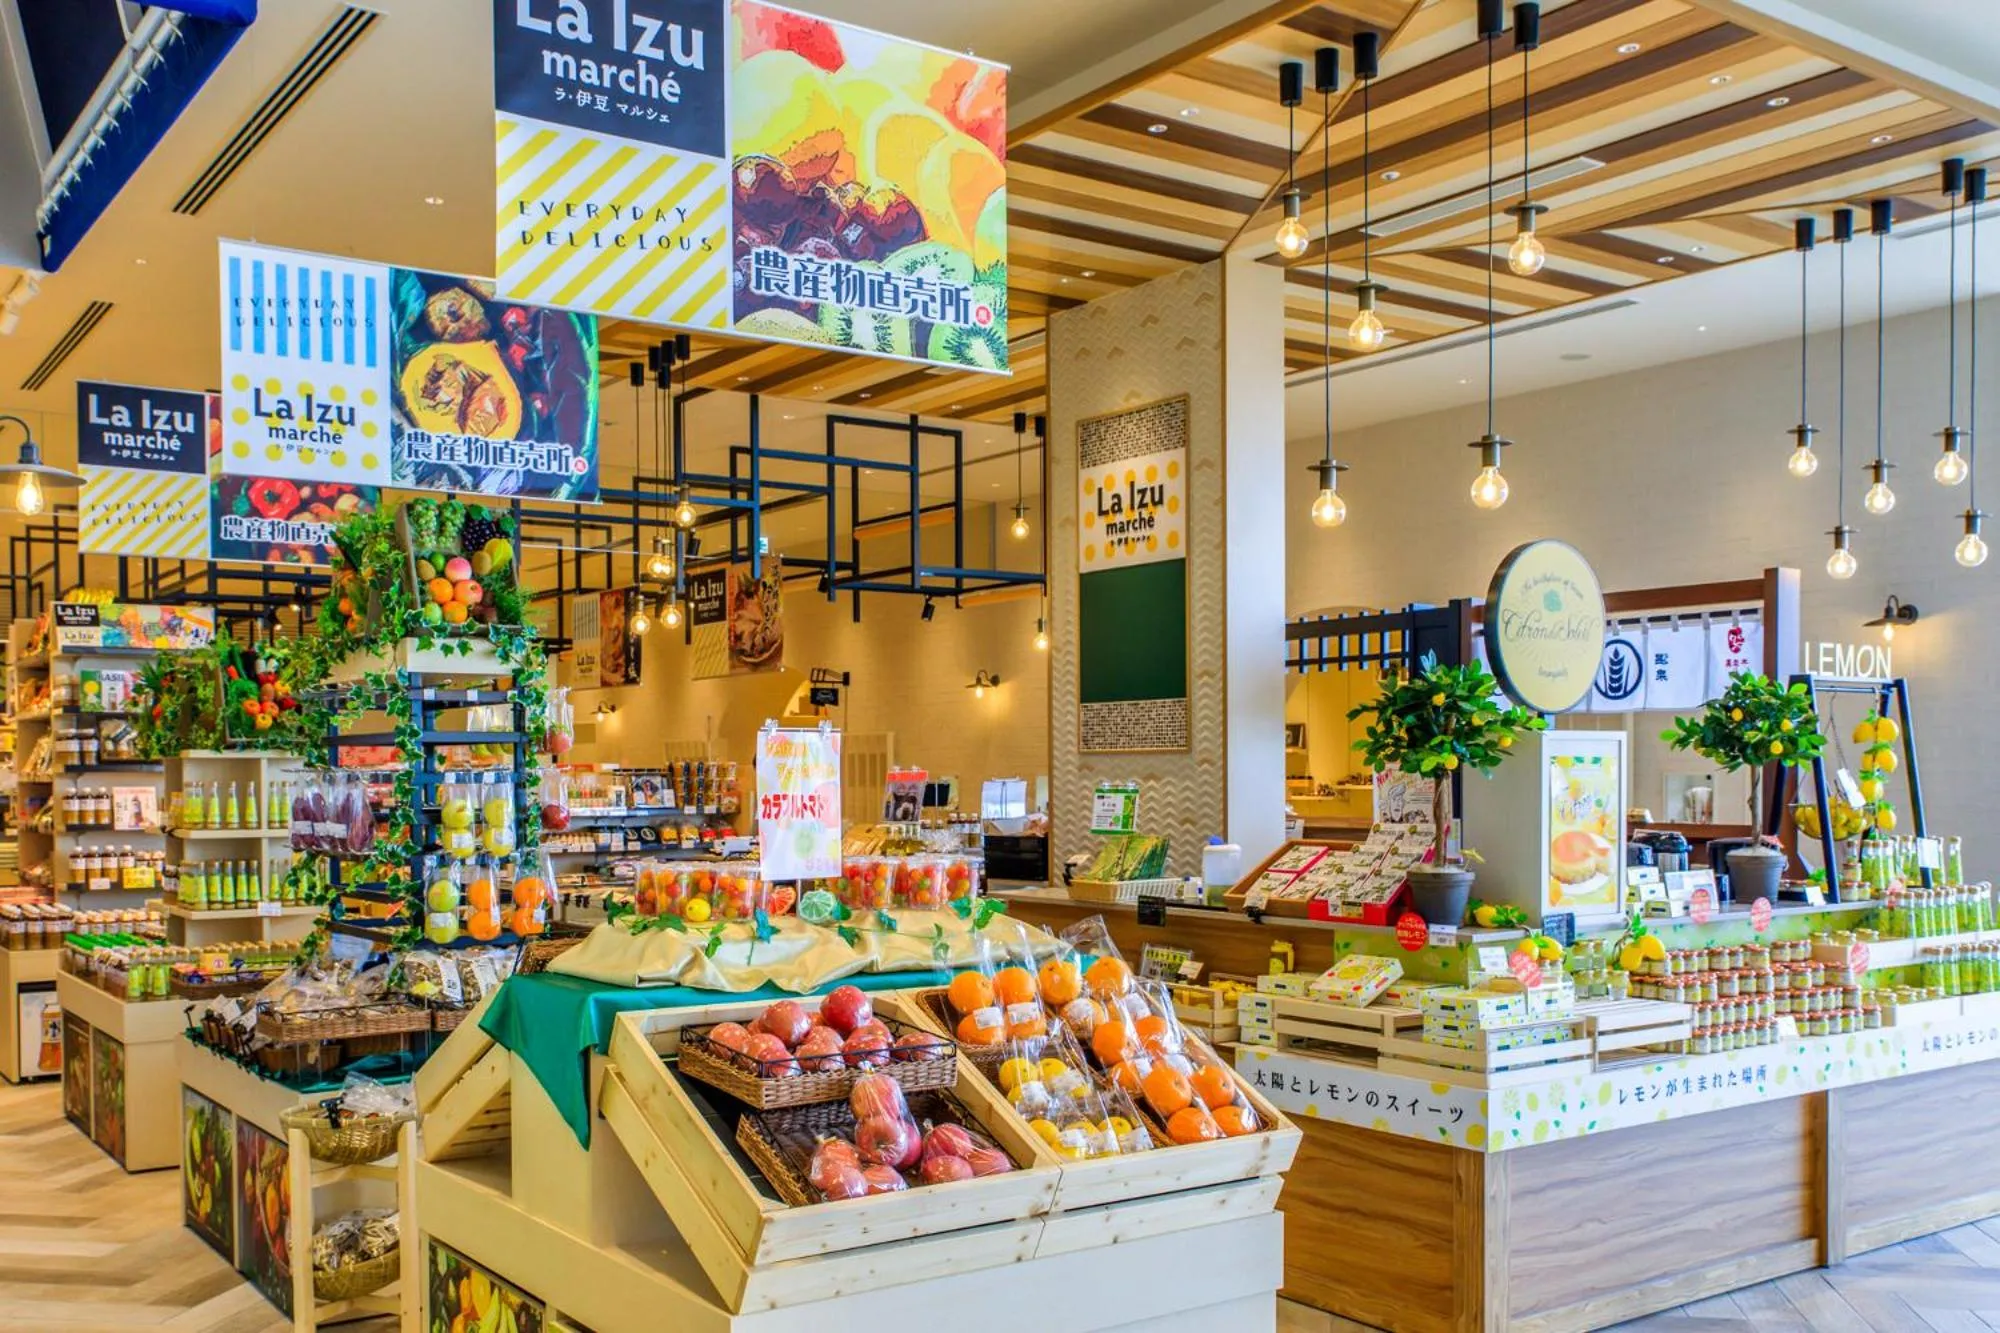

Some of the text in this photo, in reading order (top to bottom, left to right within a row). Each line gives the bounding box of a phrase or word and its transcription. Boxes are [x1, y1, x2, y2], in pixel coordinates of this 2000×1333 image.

[517, 0, 705, 71] La Izu
[542, 49, 681, 103] marché
[616, 102, 671, 124] マルシェ
[519, 200, 687, 224] EVERYDAY
[521, 230, 713, 252] DELICIOUS
[752, 249, 972, 325] 農産物直売所
[88, 393, 195, 434] La Izu
[253, 387, 356, 427] La Izu
[103, 431, 182, 451] marché
[268, 425, 343, 445] marché
[405, 431, 573, 475] 農産物直売所
[1097, 480, 1164, 517] La Izu
[1106, 511, 1155, 537] marché
[694, 578, 724, 600] La Izu
[57, 605, 73, 616] La
[1804, 641, 1892, 680] LEMON
[761, 793, 825, 820] カラフルトマト
[1253, 1069, 1465, 1124] 太陽とレモンのスイーツ
[1618, 1063, 1768, 1105] レモンが生まれた場所
